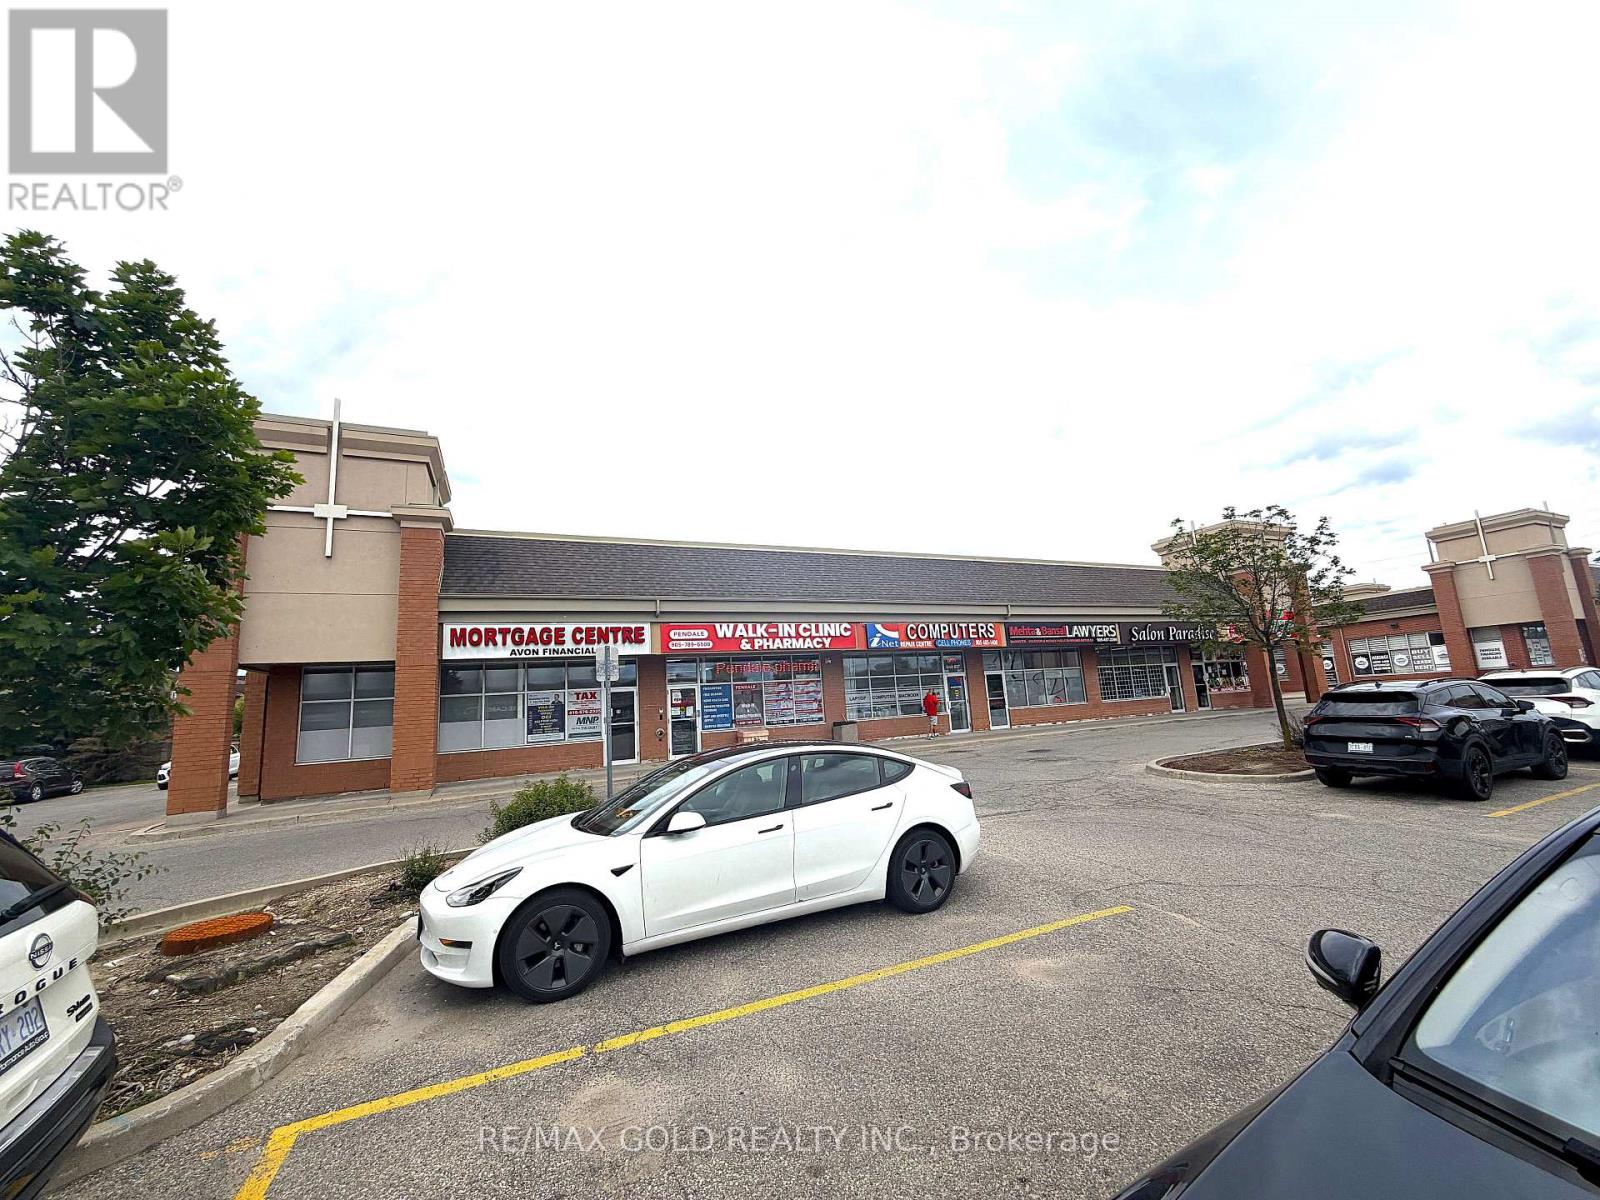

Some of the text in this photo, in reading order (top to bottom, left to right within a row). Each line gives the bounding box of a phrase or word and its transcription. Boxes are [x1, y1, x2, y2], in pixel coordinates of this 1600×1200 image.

[449, 626, 646, 648] MORTGAGE CENTRE
[714, 623, 852, 638] WALK-IN CLINIC
[907, 623, 996, 640] COMPUTERS
[1066, 624, 1117, 637] LAWYERS
[1131, 624, 1164, 641] Salon
[740, 637, 832, 650] & PHARMACY
[509, 647, 598, 657] AVON FINANCIAL
[574, 691, 598, 700] TAX
[576, 716, 600, 725] MNP
[17, 1007, 43, 1041] 202
